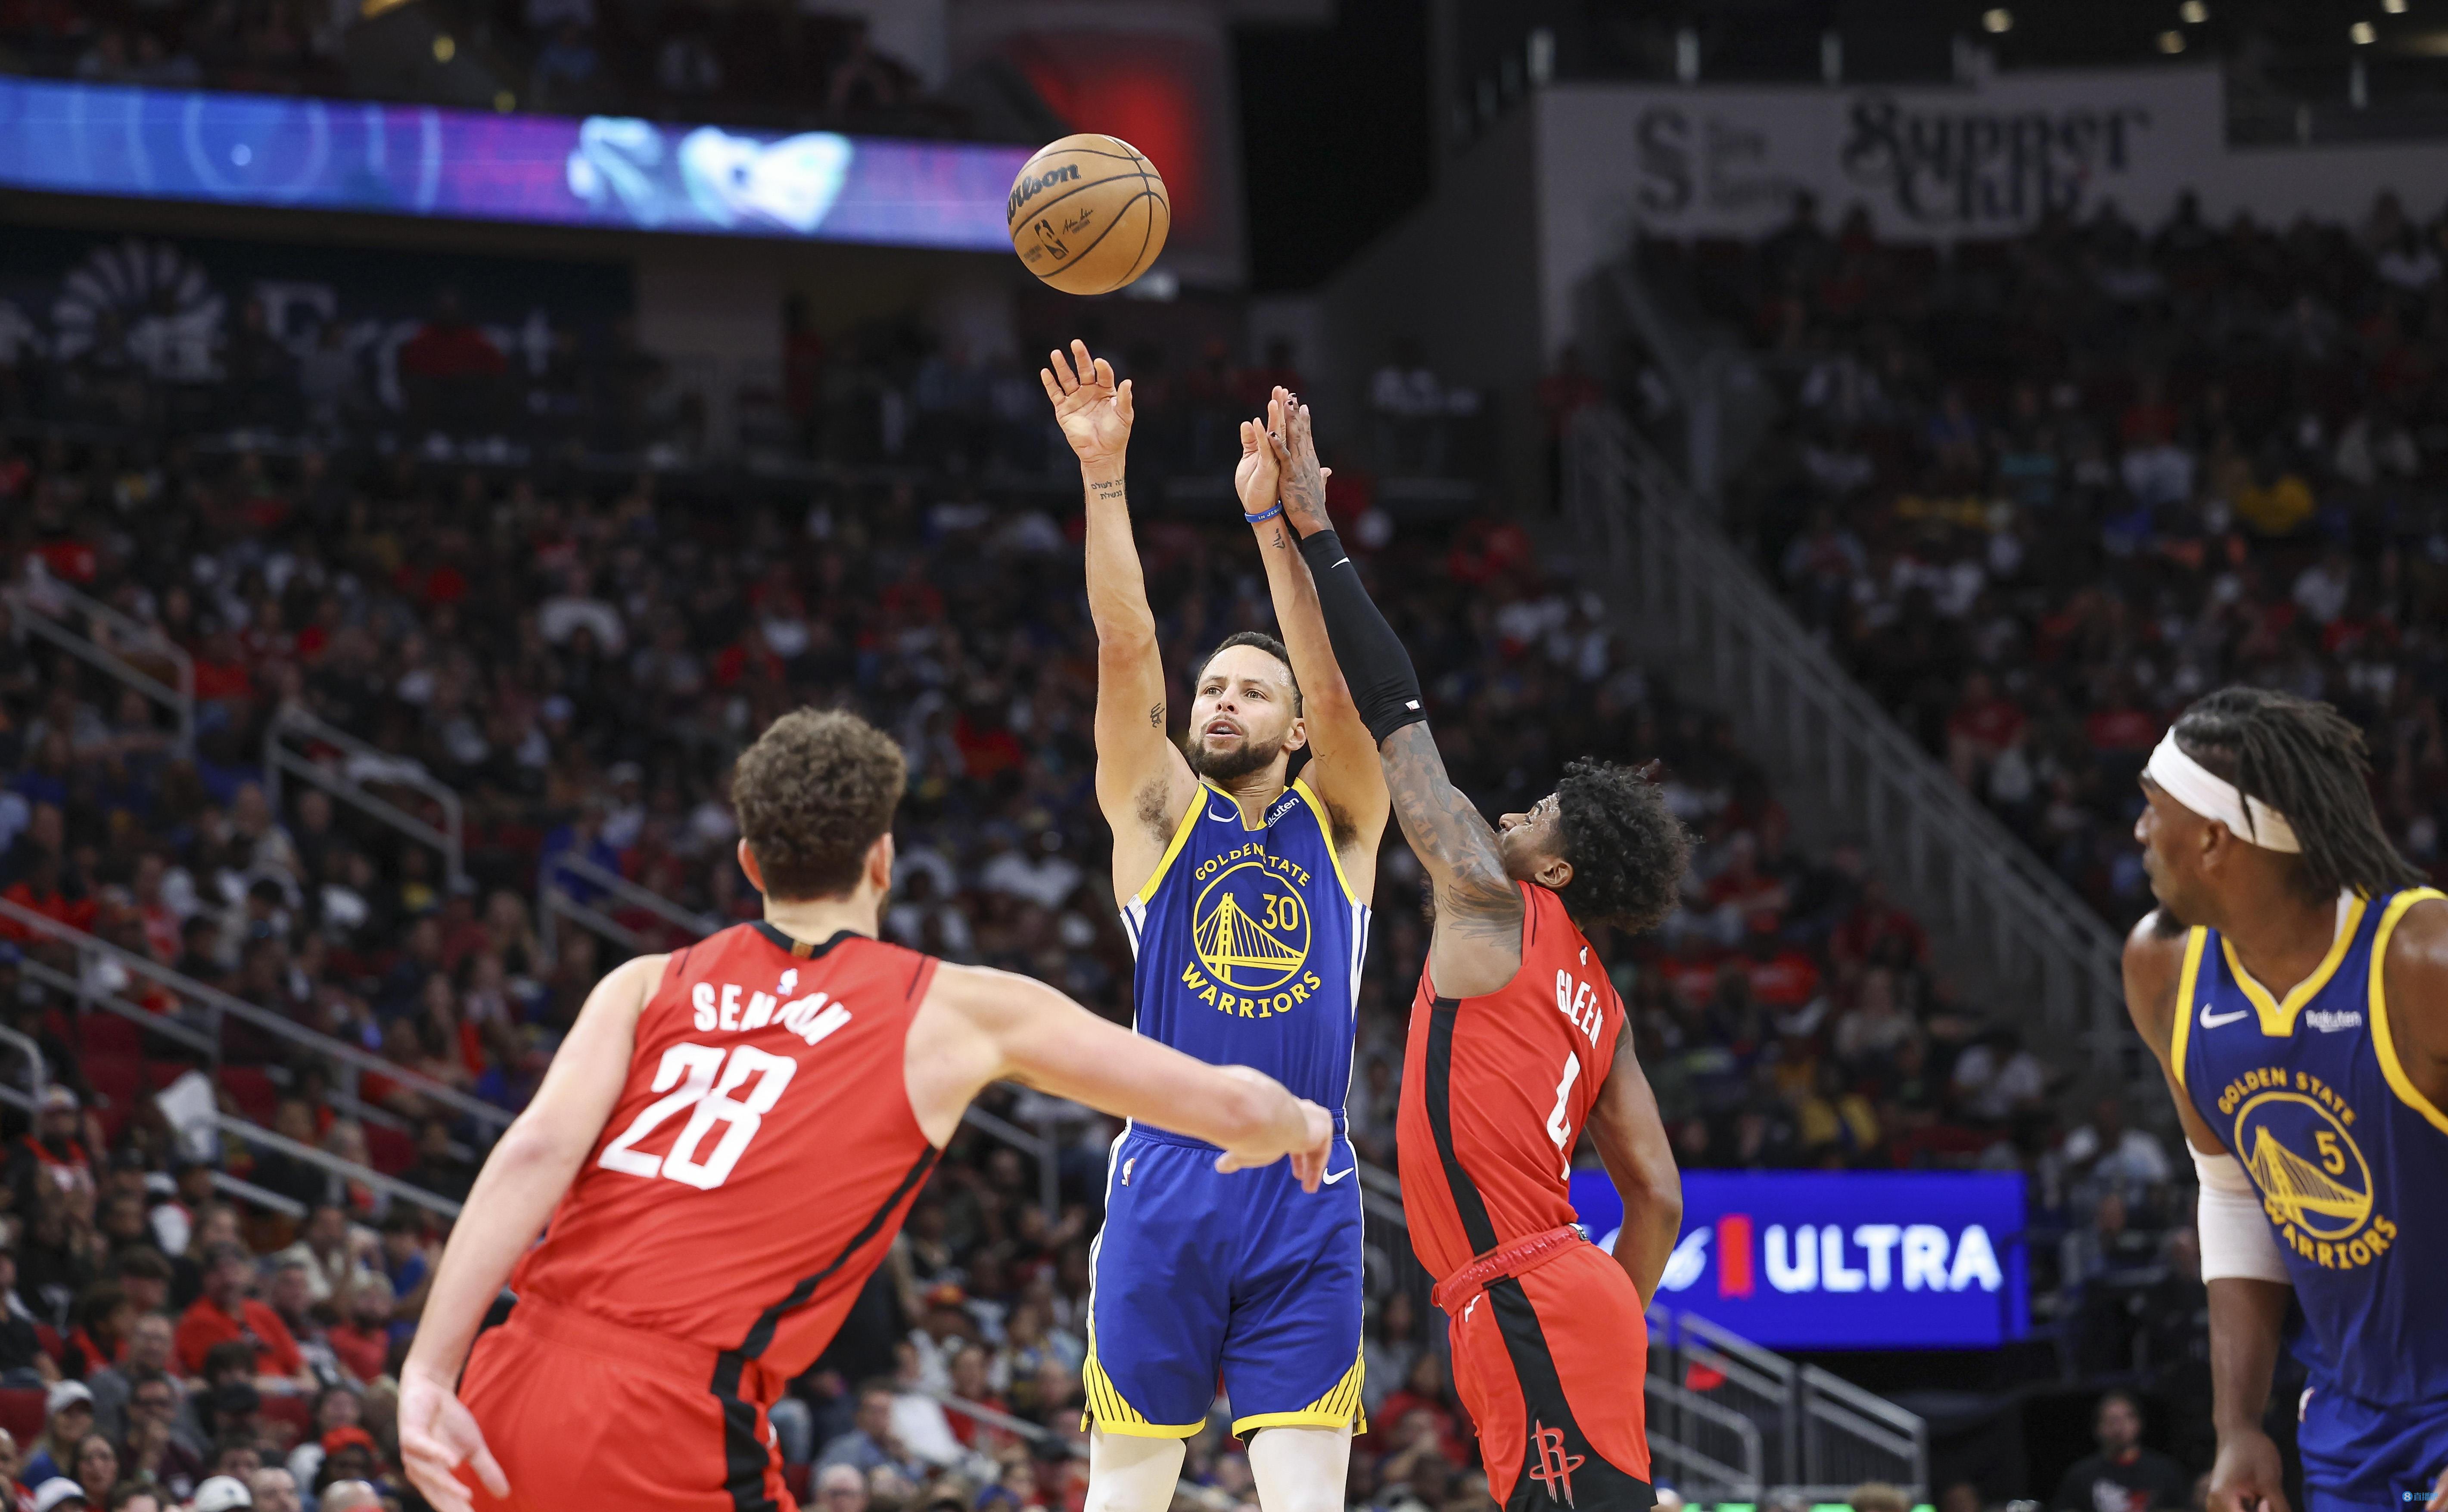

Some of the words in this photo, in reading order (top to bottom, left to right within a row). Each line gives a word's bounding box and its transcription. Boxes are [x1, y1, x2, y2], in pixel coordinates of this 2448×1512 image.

[1268, 798, 1300, 826] kuten
[1195, 842, 1263, 881] GOLDEN
[1261, 893, 1298, 931] 30
[1182, 961, 1321, 1018] WARRIORS
[597, 1041, 797, 1190] 28
[2218, 1067, 2288, 1115] GOLDEN
[2296, 1071, 2356, 1126] STATE
[2315, 1130, 2345, 1175] 5
[1764, 1223, 2003, 1293] ULTRA
